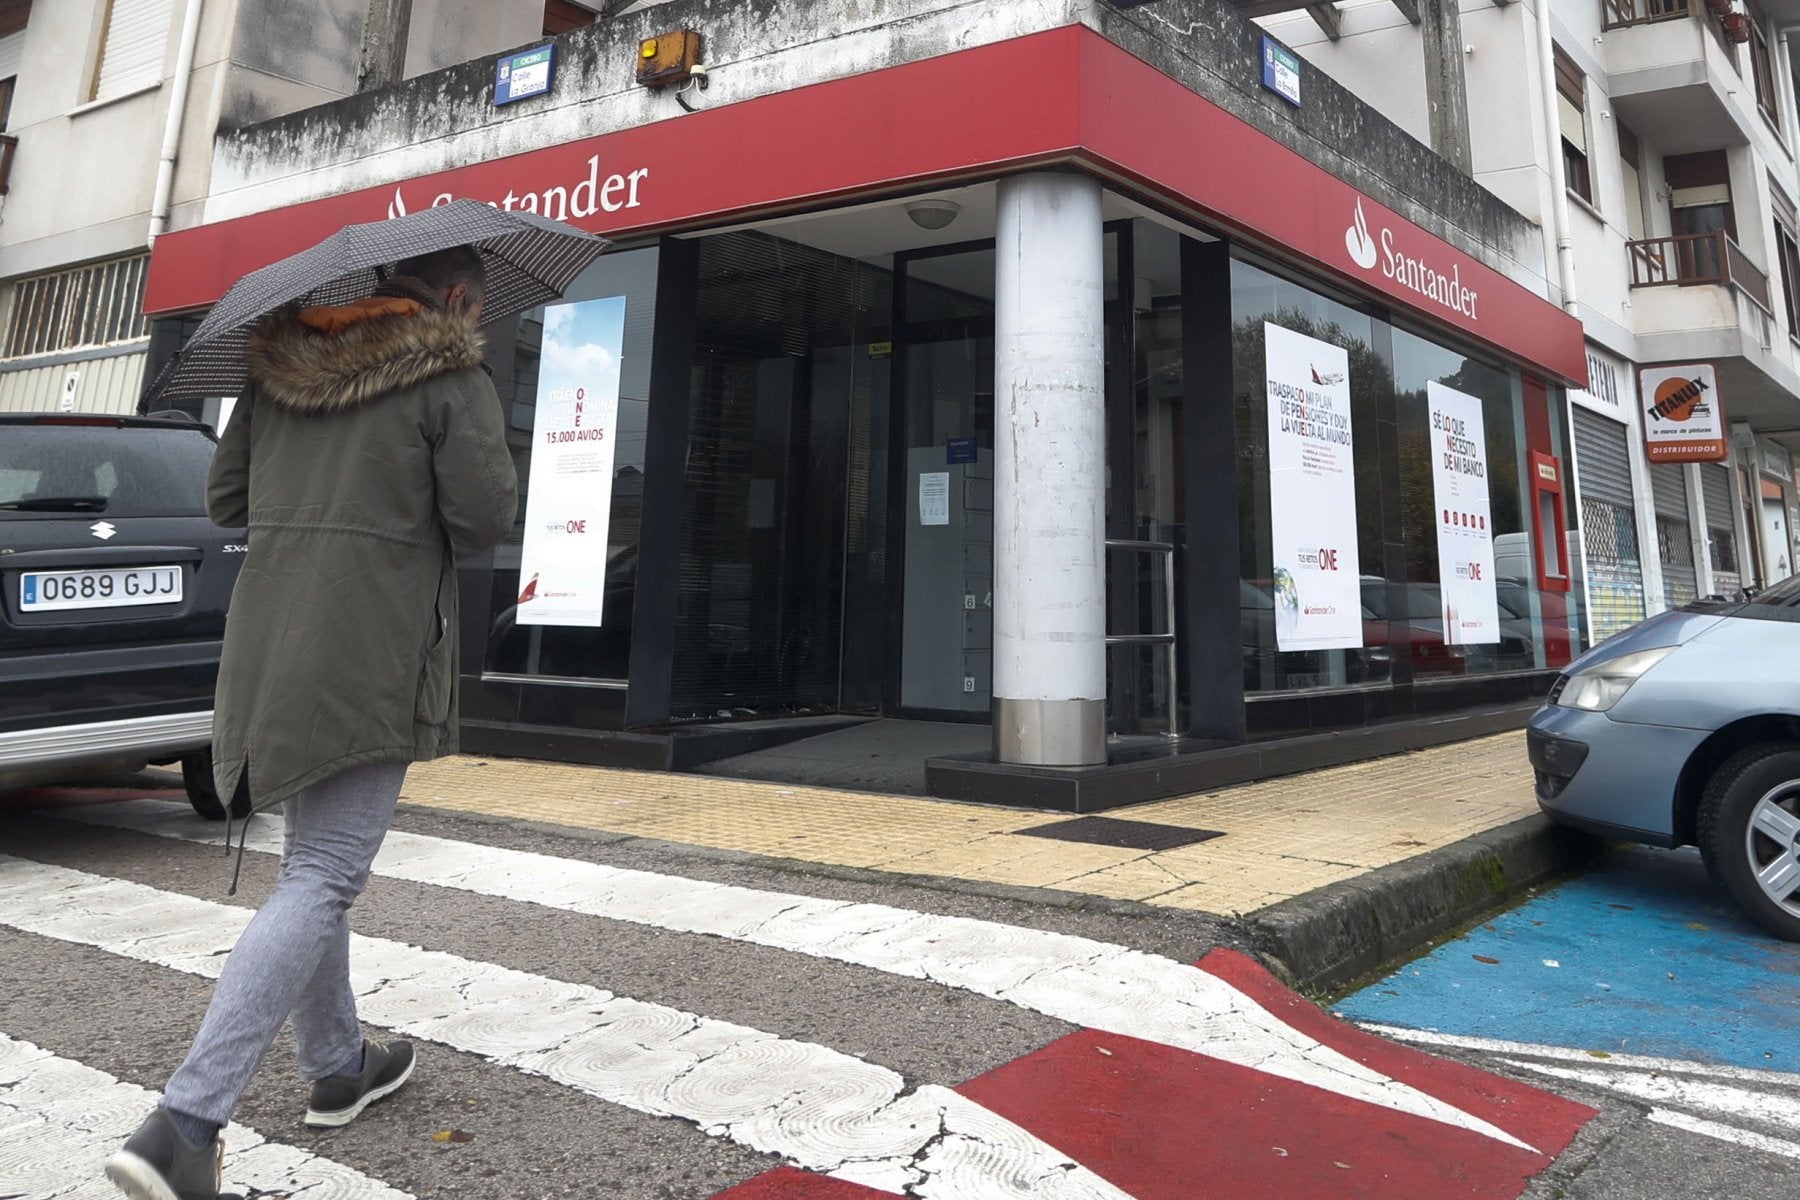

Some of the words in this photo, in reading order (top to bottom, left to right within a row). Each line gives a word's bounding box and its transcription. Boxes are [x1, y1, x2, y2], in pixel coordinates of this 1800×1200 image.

[520, 53, 541, 65] CICERO
[513, 70, 530, 82] Calle
[1276, 62, 1288, 79] Calle
[520, 81, 545, 92] Granja
[1381, 228, 1478, 320] Santander
[1268, 380, 1304, 403] TRASPASO
[1306, 390, 1314, 406] MI
[1315, 392, 1332, 410] PLAN
[1647, 376, 1710, 422] TITANLUX
[1280, 400, 1290, 416] DE
[1291, 402, 1328, 426] PENSIONES
[1328, 412, 1334, 426] Y
[1334, 414, 1348, 430] DOY
[1433, 409, 1442, 430] SÉ
[1442, 414, 1450, 432] LO
[1452, 418, 1466, 437] QUE
[546, 431, 576, 444] 15.000
[576, 428, 604, 440] AVIOS
[1281, 416, 1290, 433] LA
[1291, 418, 1316, 439] VUELTA
[1318, 426, 1326, 440] AL
[1326, 428, 1351, 446] MUNDO
[1446, 434, 1476, 458] NECESITO
[1652, 445, 1716, 454] DISTRIBUIDOR
[1444, 452, 1453, 470] DE
[1454, 456, 1462, 472] MI
[1462, 458, 1484, 478] BANCO
[566, 520, 586, 534] ONE
[1298, 554, 1306, 563] TUS
[1318, 548, 1338, 570] ONE
[1468, 562, 1482, 580] ONE
[43, 574, 114, 600] 0689
[124, 572, 174, 596] GJJ
[966, 597, 974, 608] 6
[966, 680, 973, 690] 9
